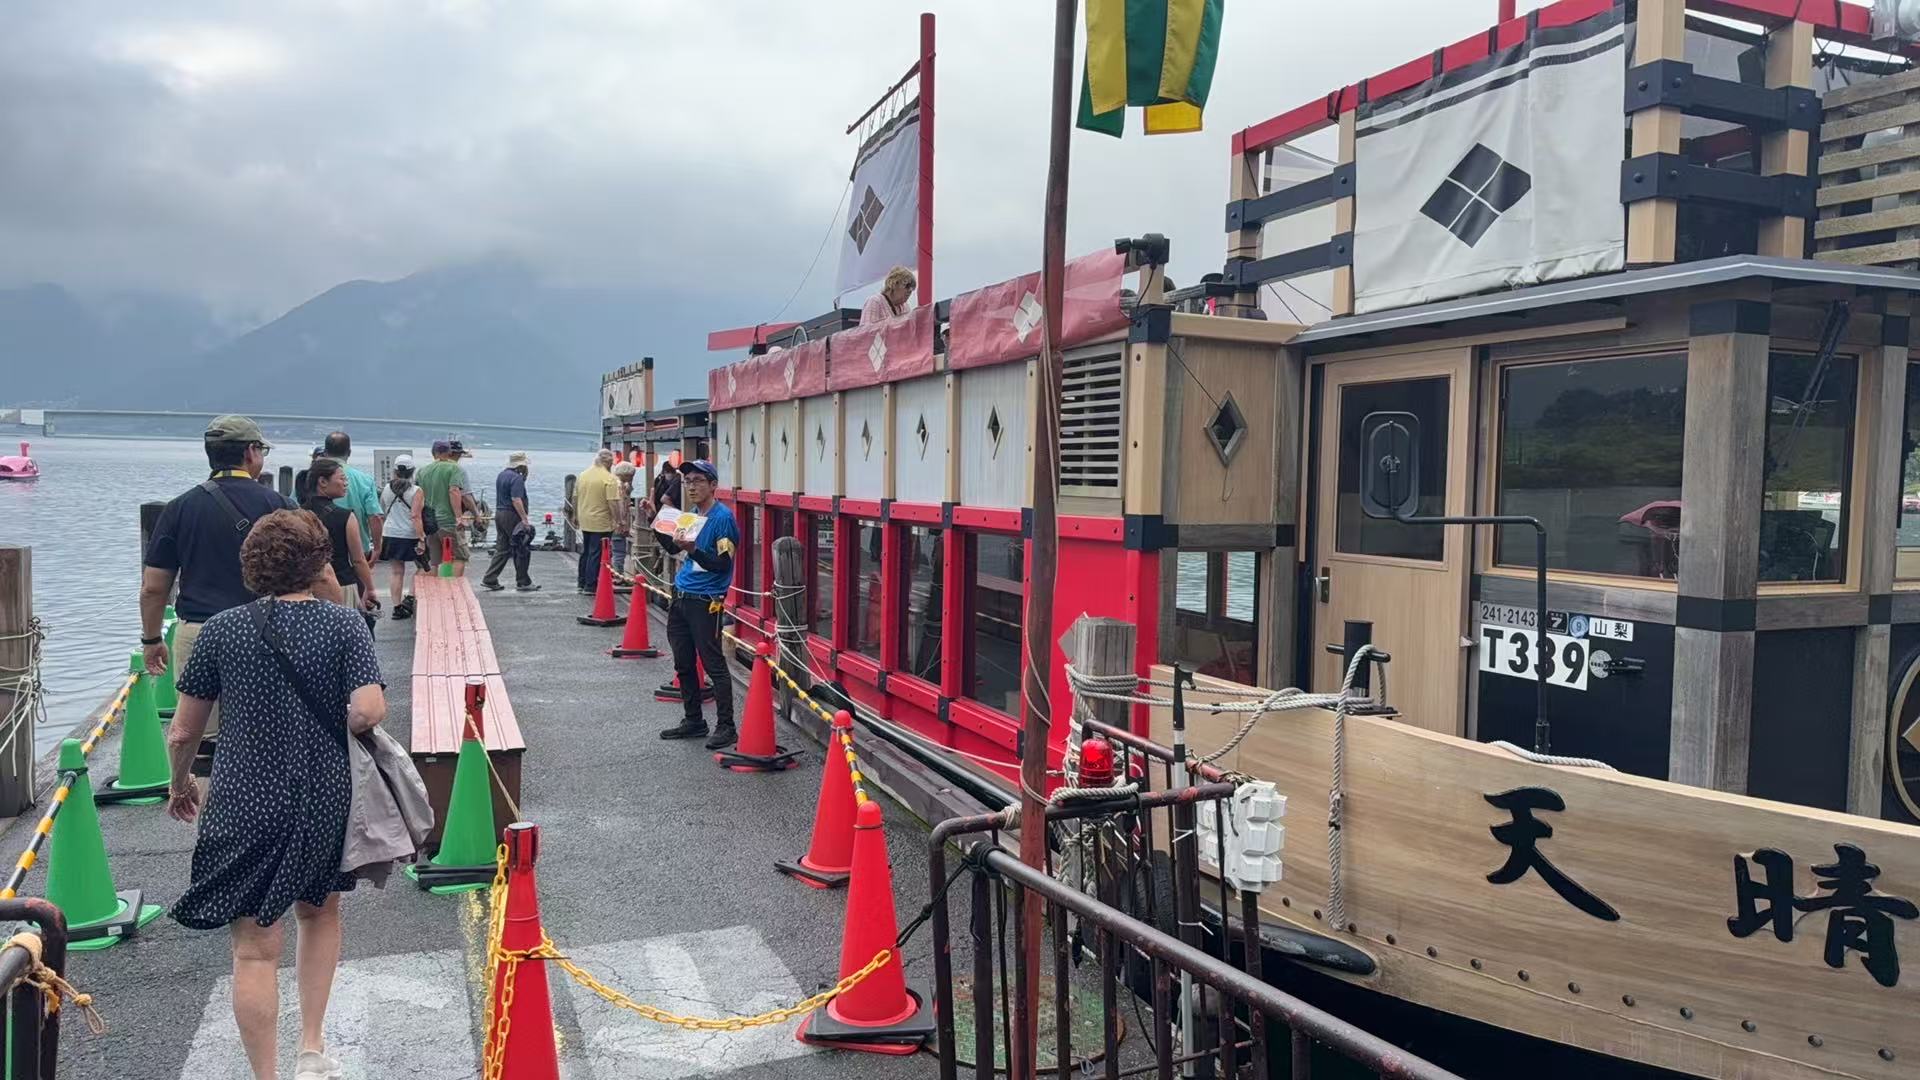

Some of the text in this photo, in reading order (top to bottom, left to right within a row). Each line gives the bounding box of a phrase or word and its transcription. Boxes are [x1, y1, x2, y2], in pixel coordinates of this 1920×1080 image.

[1482, 605, 1545, 628] 241-2143
[1594, 620, 1628, 639] 山梨
[1482, 627, 1586, 684] T339
